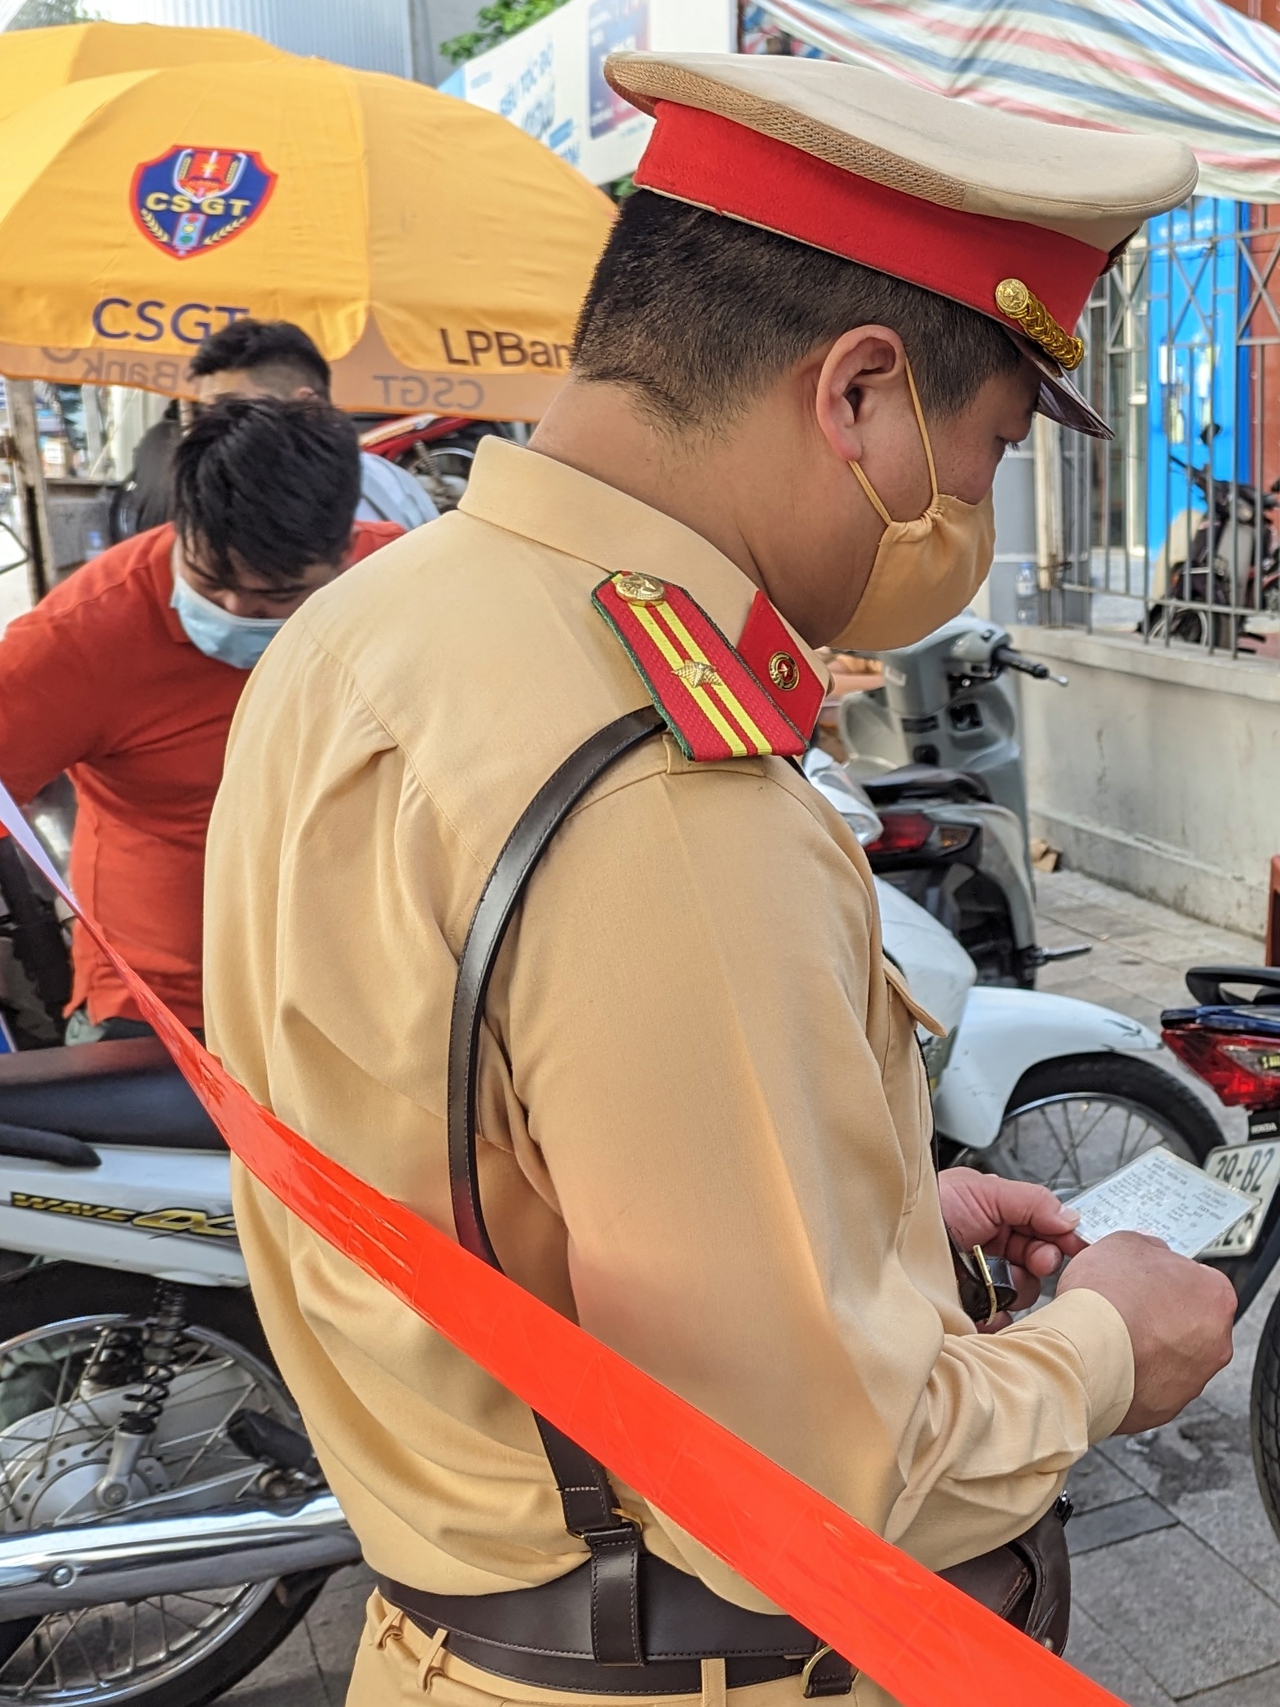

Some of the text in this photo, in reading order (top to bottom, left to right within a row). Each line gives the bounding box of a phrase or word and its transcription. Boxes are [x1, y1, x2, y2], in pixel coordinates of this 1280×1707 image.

[145, 192, 252, 216] CSGT
[440, 328, 573, 369] LPBan
[1250, 1122, 1278, 1135] HONDA
[13, 1193, 138, 1222] WAVE
